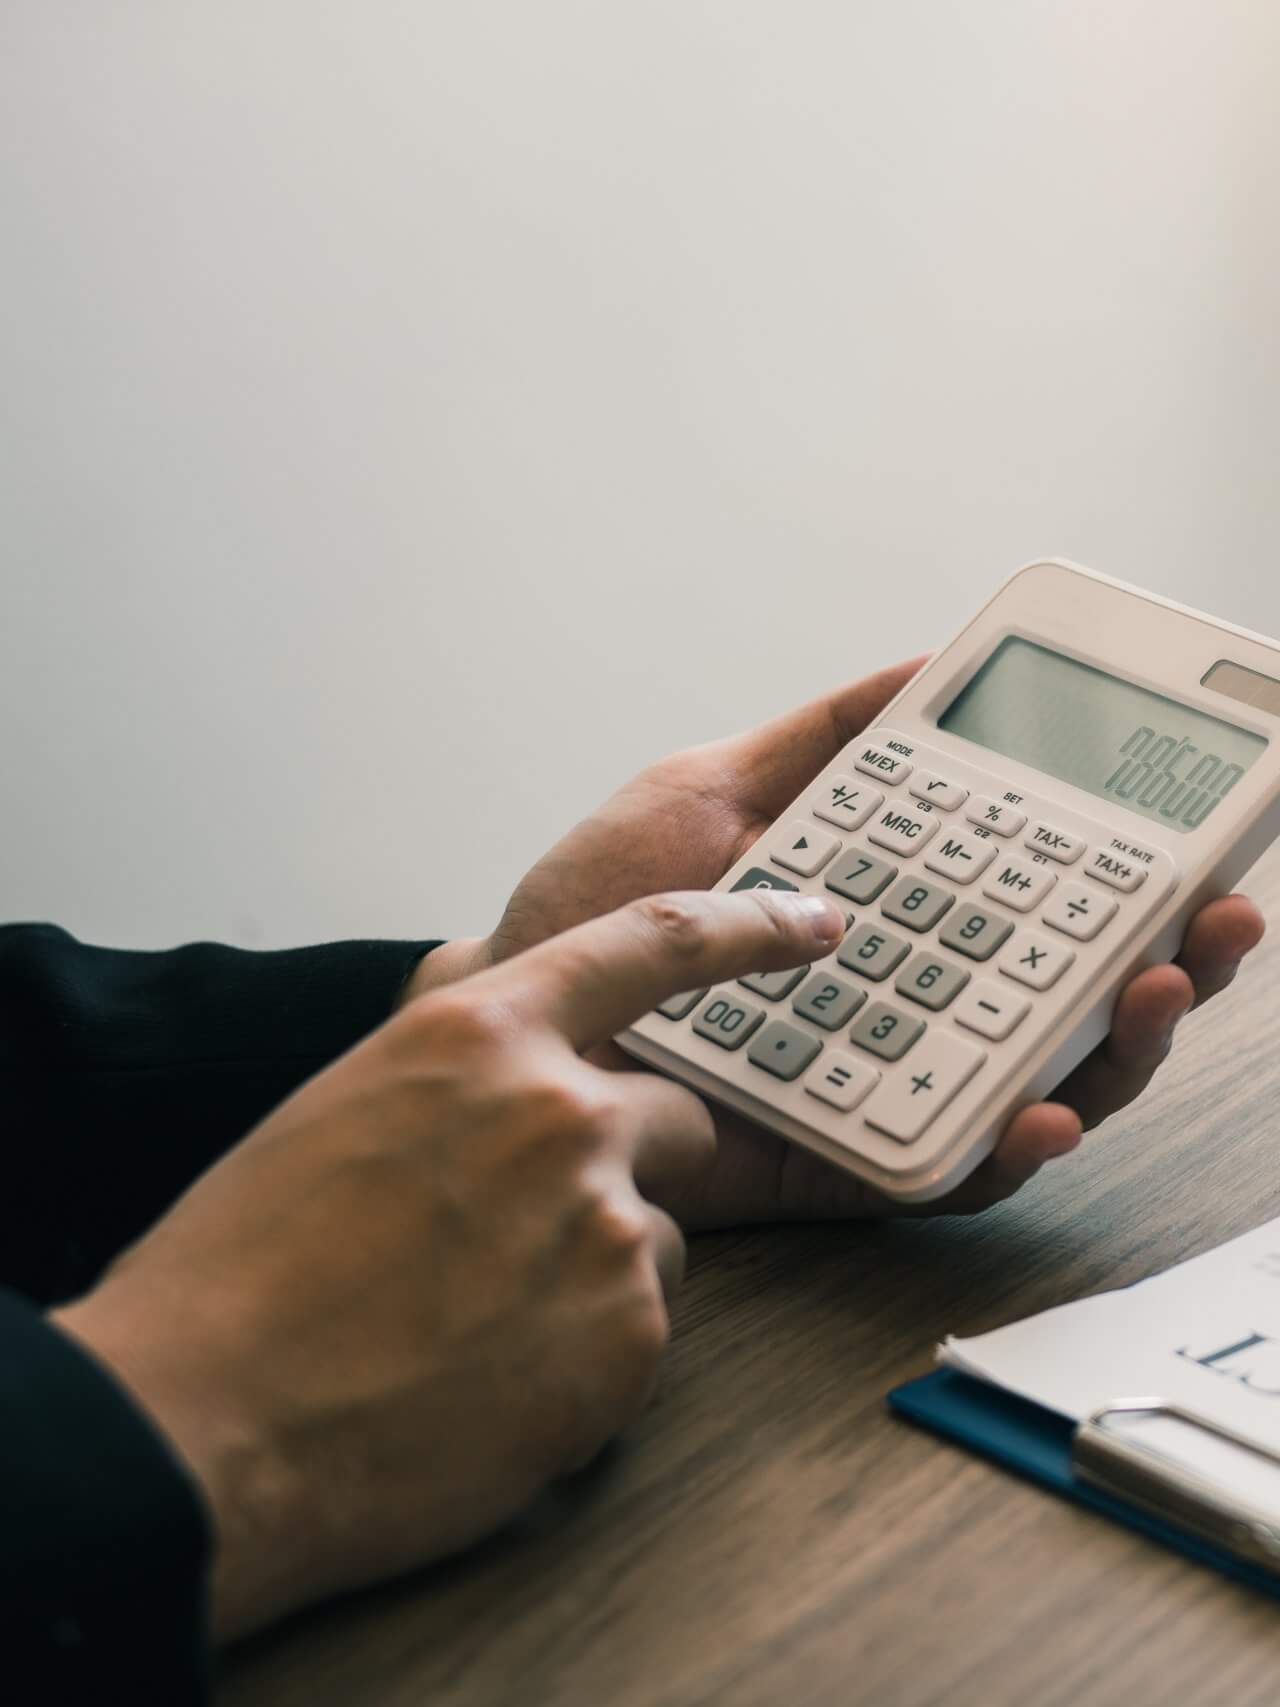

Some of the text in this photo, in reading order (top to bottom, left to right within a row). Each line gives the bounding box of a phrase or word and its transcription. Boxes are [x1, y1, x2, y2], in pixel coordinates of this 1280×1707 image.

[886, 741, 914, 757] MODE
[861, 750, 901, 773] M/EX
[916, 801, 933, 813] C3
[881, 811, 922, 838] MRC
[1110, 839, 1155, 864] TAX RATE
[845, 859, 873, 880] 7
[1094, 853, 1131, 879] TAX+
[998, 868, 1032, 891] M+
[902, 888, 928, 911] 8
[960, 916, 987, 939] 9
[857, 935, 886, 959] 5
[916, 964, 944, 989] 6
[811, 984, 840, 1011] 2
[703, 1000, 746, 1033] 00
[870, 1015, 898, 1040] 3
